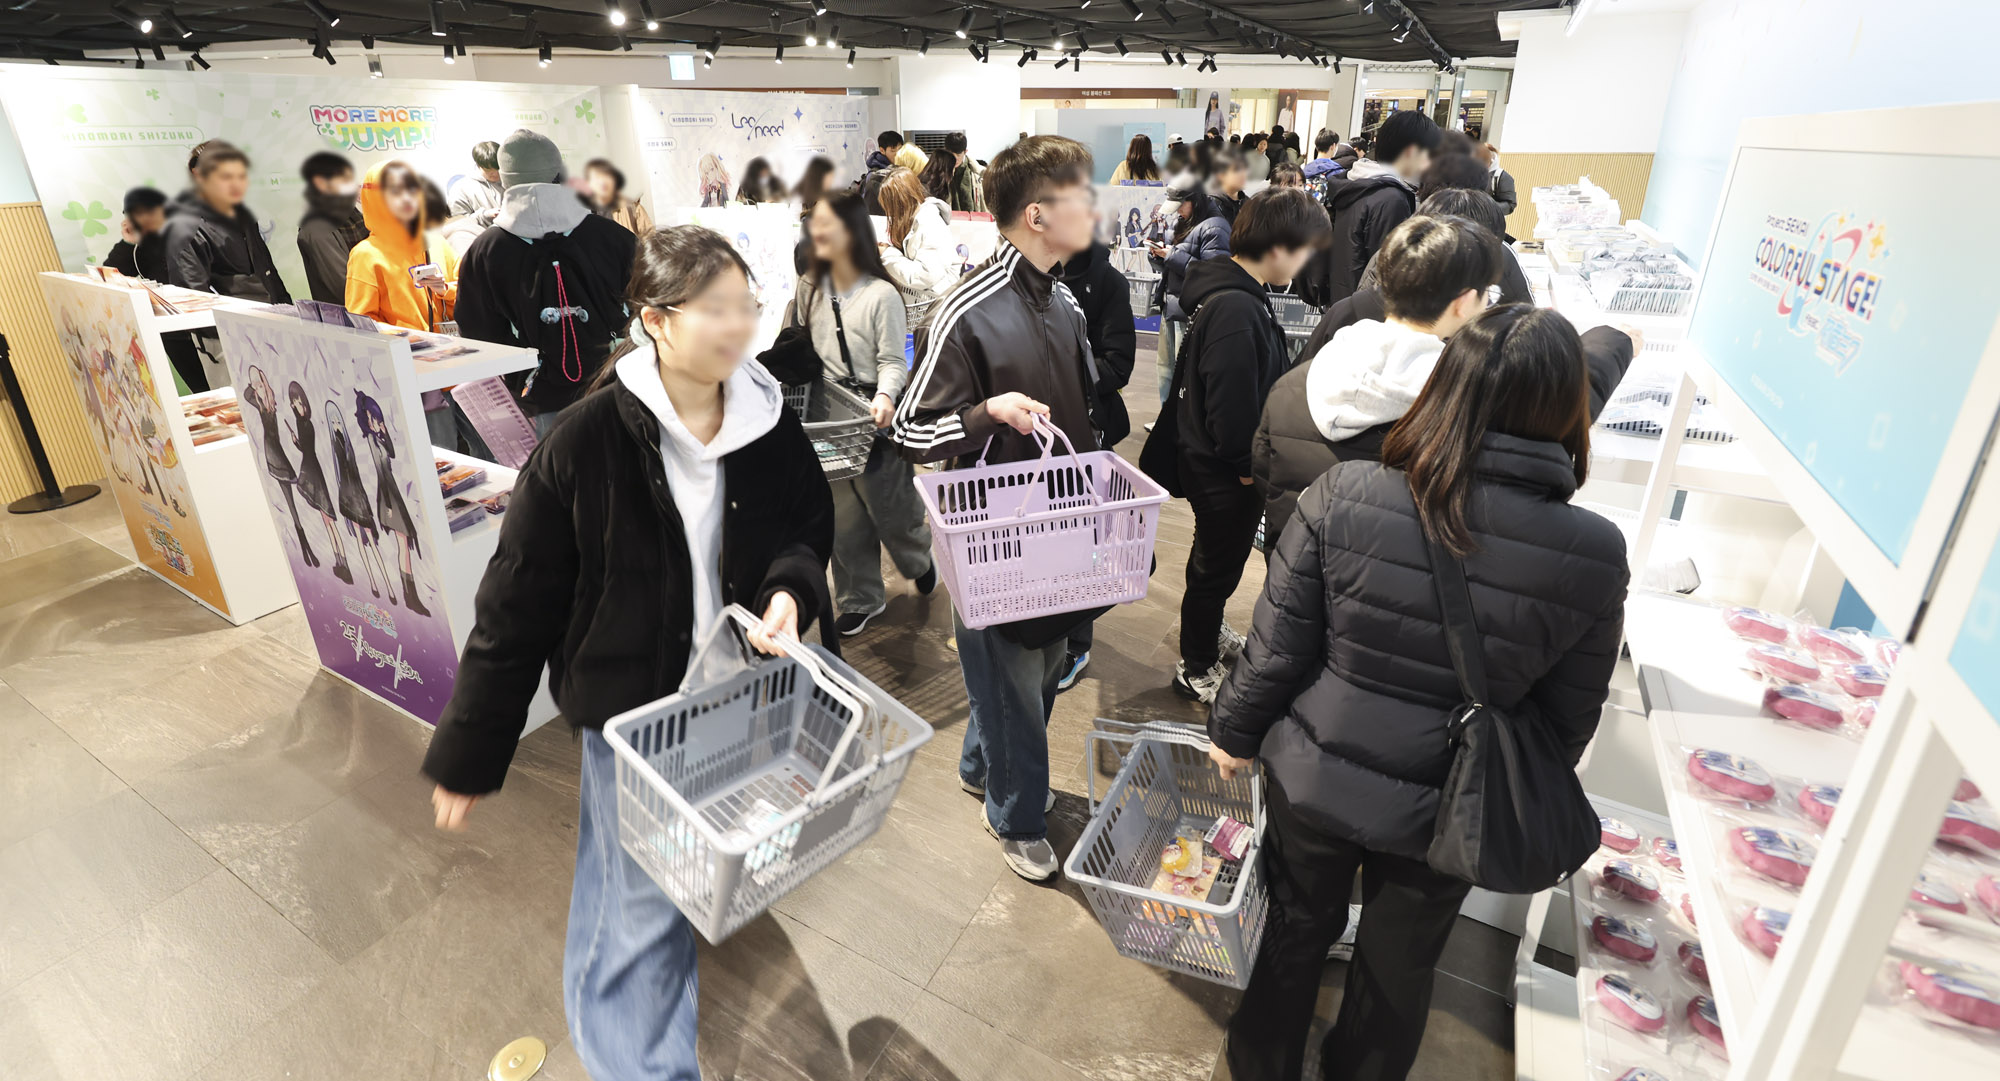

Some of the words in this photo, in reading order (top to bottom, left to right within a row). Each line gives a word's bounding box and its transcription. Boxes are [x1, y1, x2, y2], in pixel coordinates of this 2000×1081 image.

[313, 108, 378, 123] MORE
[378, 109, 436, 123] MORE
[138, 130, 194, 141] SHIZUKU
[328, 126, 434, 149] JUMP!
[1756, 237, 1816, 290] COLORFUL
[1813, 258, 1883, 321] STAGE!
